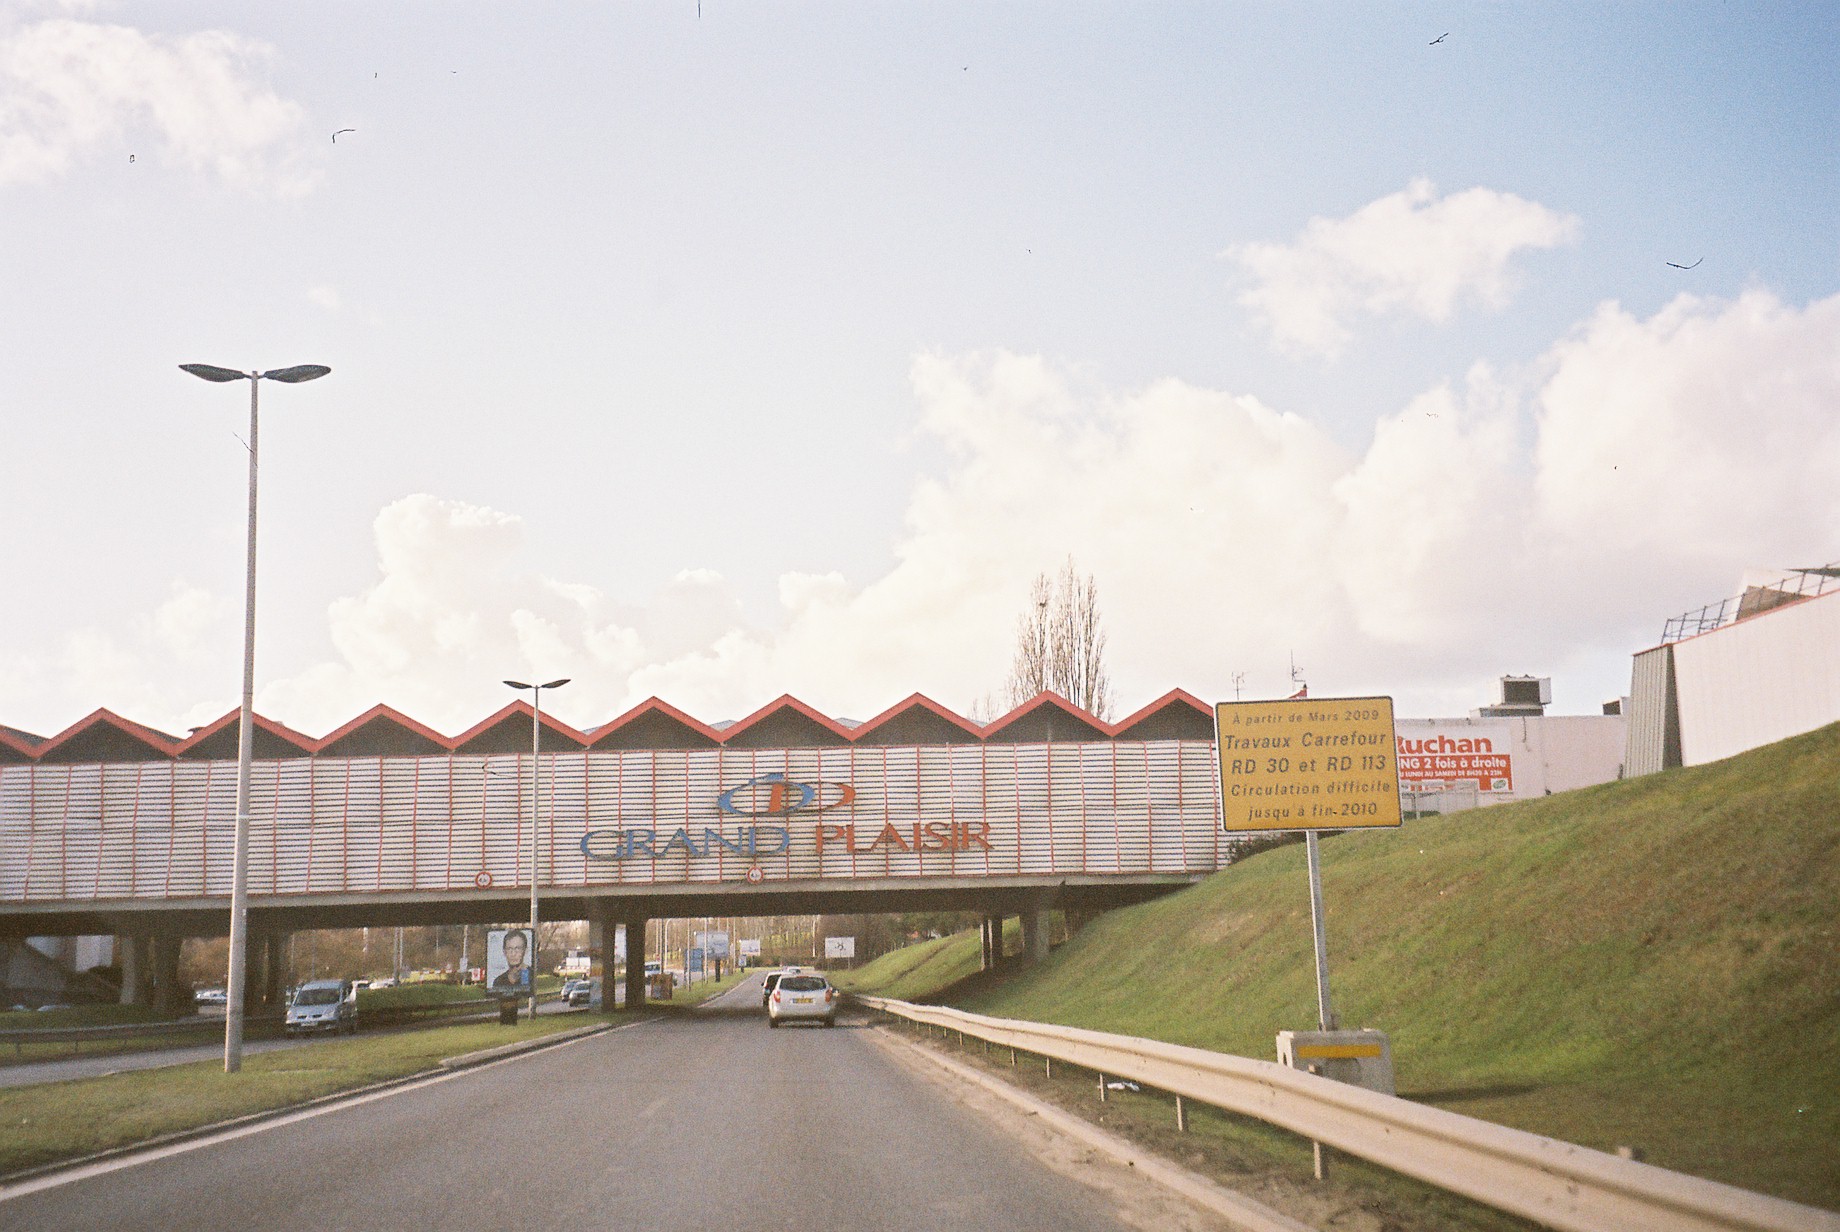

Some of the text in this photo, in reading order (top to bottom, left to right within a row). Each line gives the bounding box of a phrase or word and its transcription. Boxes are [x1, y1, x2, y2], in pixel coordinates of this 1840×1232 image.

[1246, 714, 1282, 726] partir
[1288, 713, 1303, 722] de
[1308, 712, 1338, 721] Mars
[1344, 709, 1379, 720] 2009
[1225, 730, 1386, 749] Travaux Carrefour
[1232, 754, 1386, 774] RD 30 et RD 113
[1424, 757, 1432, 769] 2
[1435, 756, 1457, 769] fois
[1471, 756, 1507, 768] droite
[1231, 780, 1390, 797] Circulation difficile
[1341, 801, 1377, 816] 2010
[580, 821, 995, 859] GRAND PLAISIR
